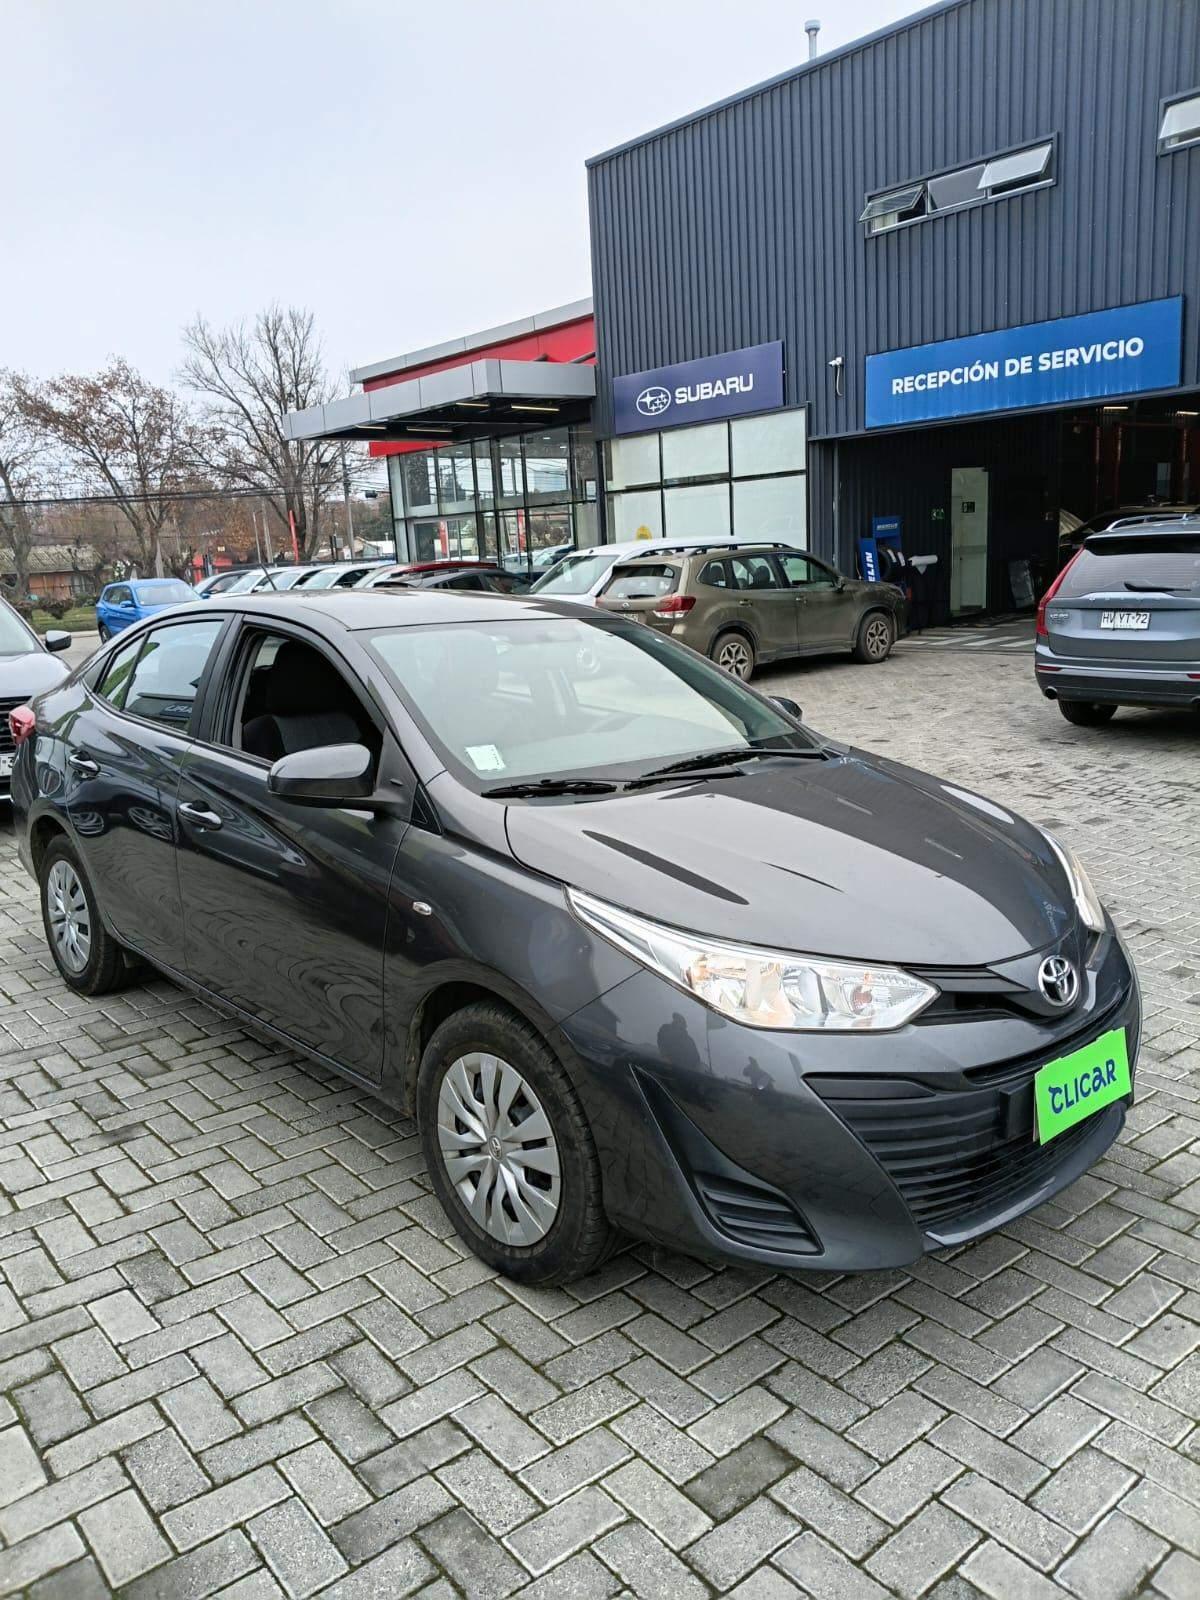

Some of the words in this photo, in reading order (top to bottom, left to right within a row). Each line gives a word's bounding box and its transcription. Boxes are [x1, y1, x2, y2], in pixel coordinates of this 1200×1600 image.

[892, 360, 999, 395] RECEPCIÓN
[1004, 355, 1033, 377] DE
[1038, 337, 1144, 371] SERVICIO
[674, 373, 754, 404] SUBARU
[865, 551, 876, 582] ELIN
